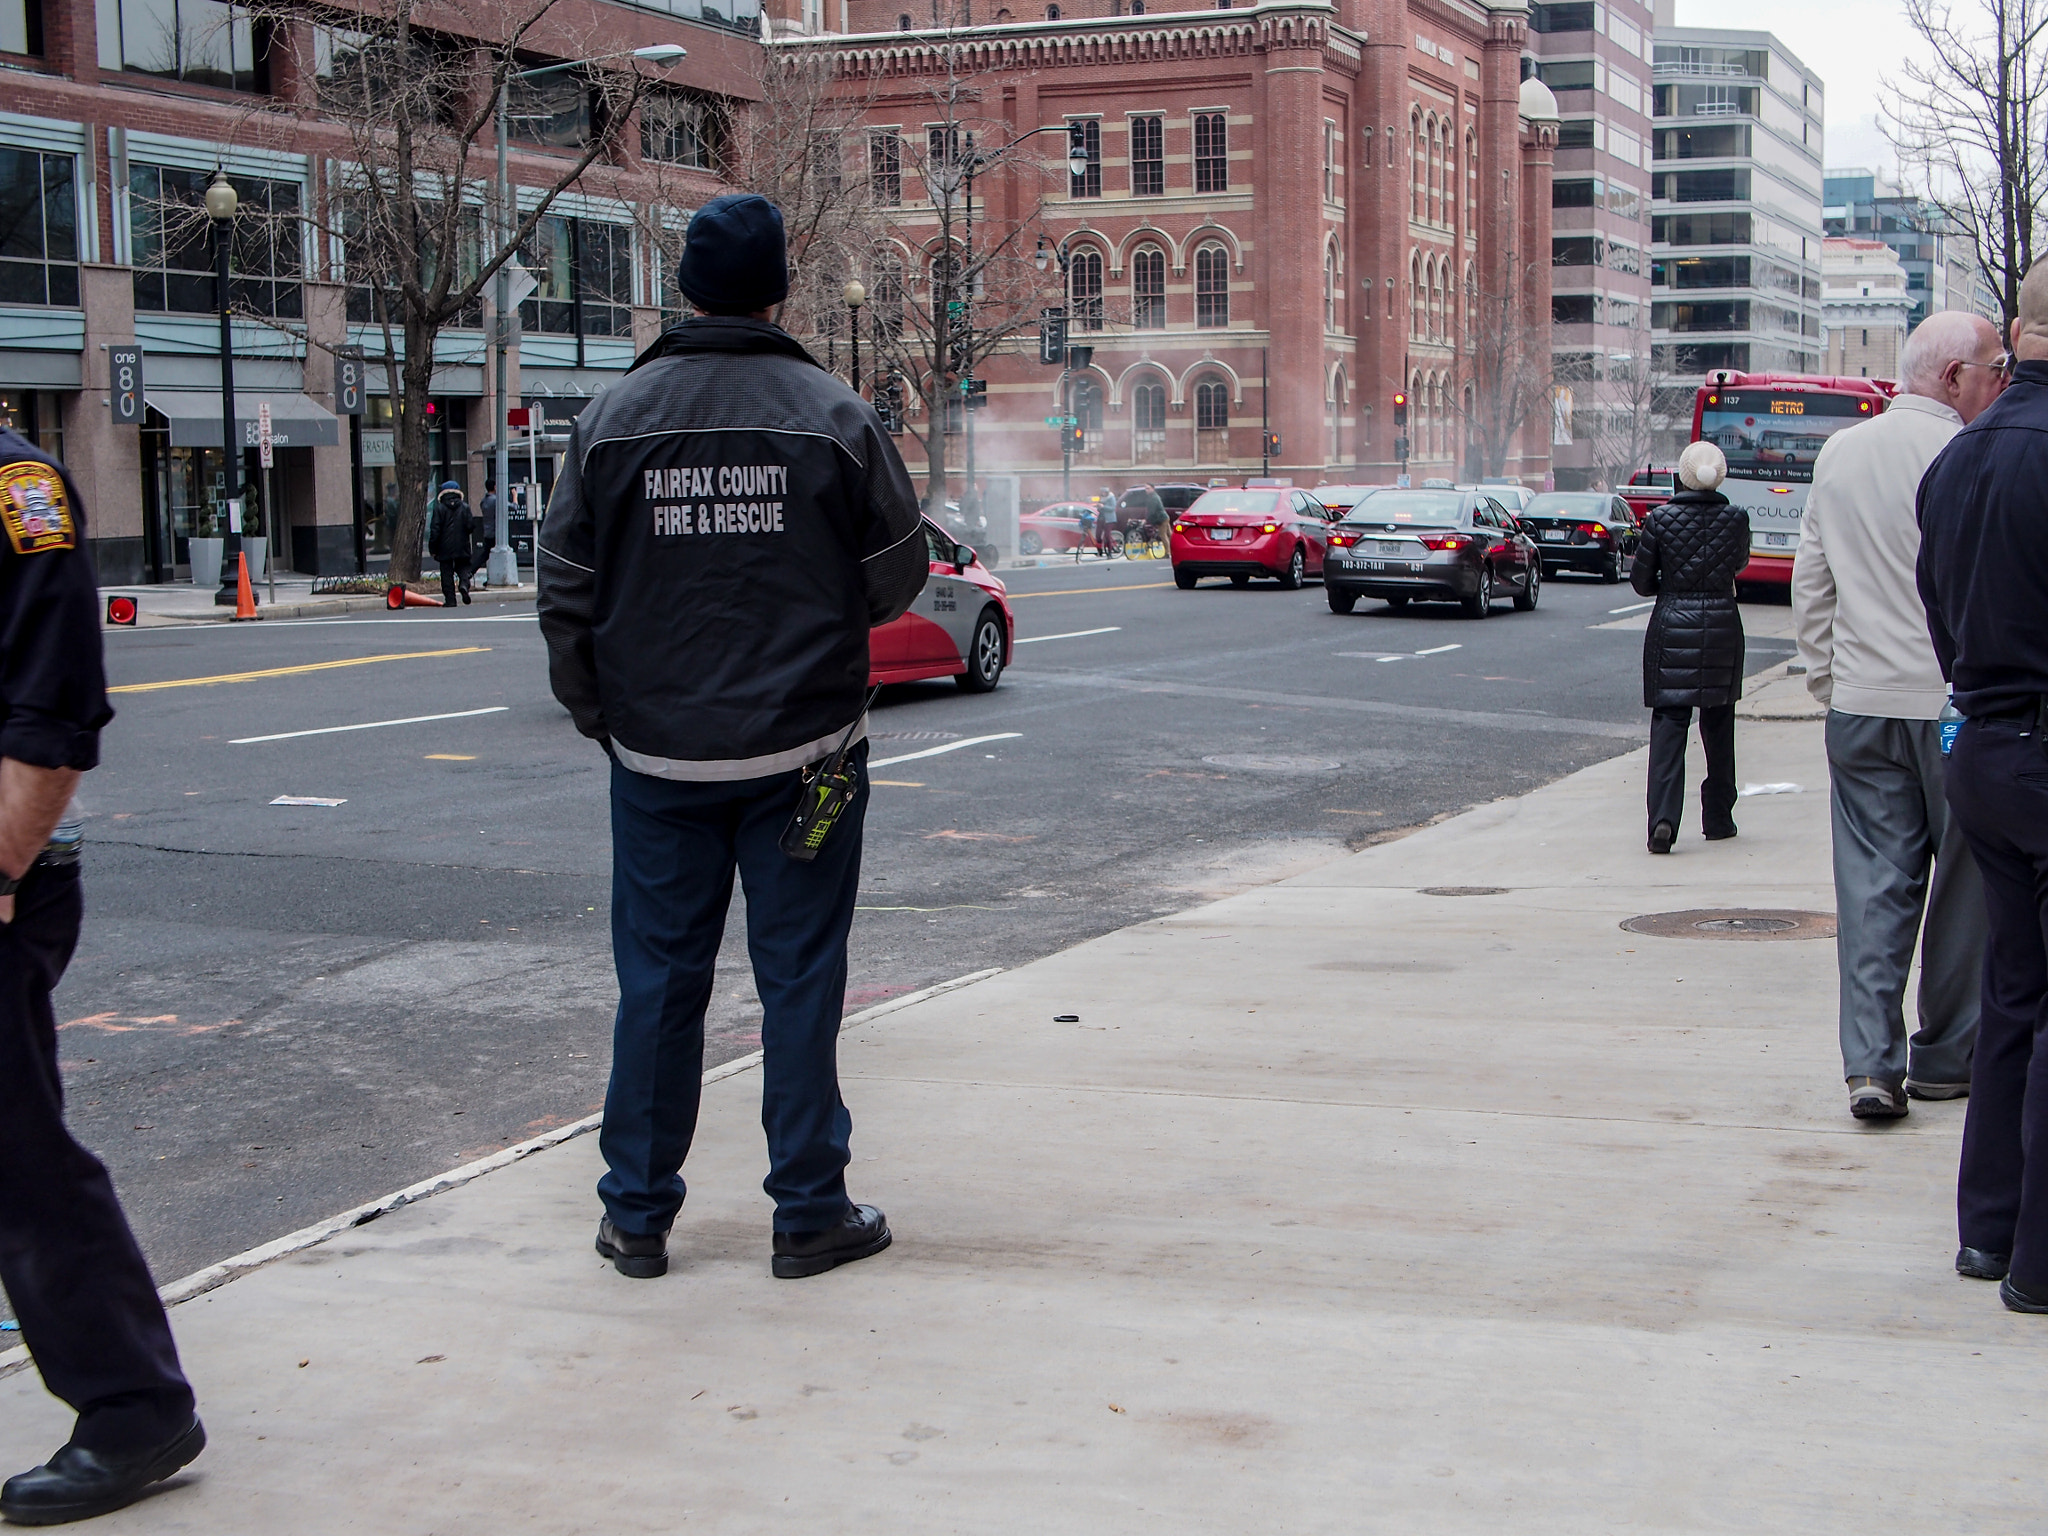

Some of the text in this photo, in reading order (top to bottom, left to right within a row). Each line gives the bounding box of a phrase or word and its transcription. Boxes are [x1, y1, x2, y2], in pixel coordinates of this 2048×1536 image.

[115, 353, 136, 364] one
[1770, 401, 1804, 414] METRO
[1729, 467, 1752, 475] Minutes
[1758, 468, 1772, 477] Only
[644, 465, 788, 500] FAIRFAX COUNTY
[653, 502, 785, 536] FIRE & RESCUE
